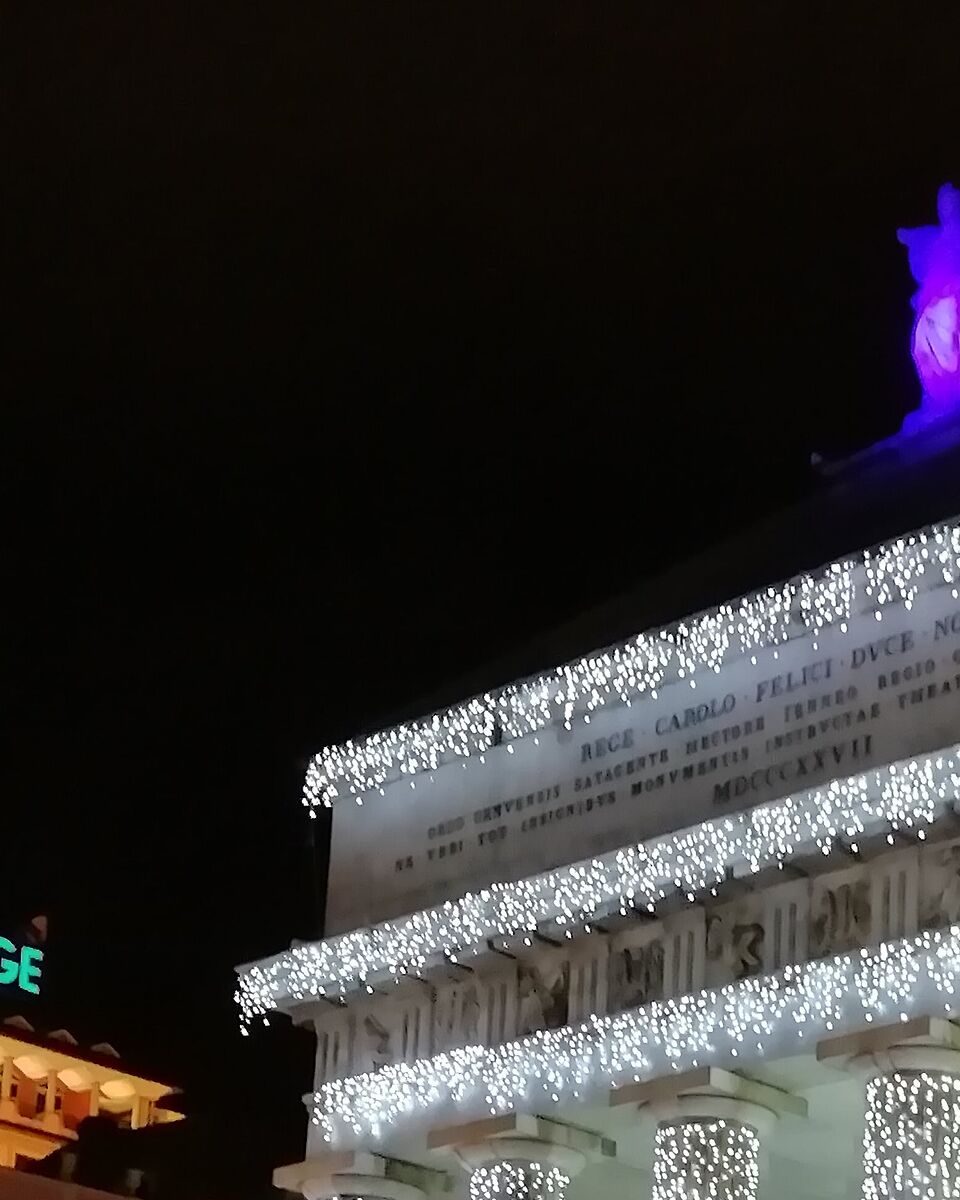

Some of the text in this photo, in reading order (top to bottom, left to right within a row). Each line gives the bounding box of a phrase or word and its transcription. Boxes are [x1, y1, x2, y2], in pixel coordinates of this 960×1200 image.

[655, 690, 736, 737] CAROLO
[755, 656, 832, 703] FELICI
[850, 627, 914, 671] DVCE
[711, 732, 872, 807] MDCCCXXVII
